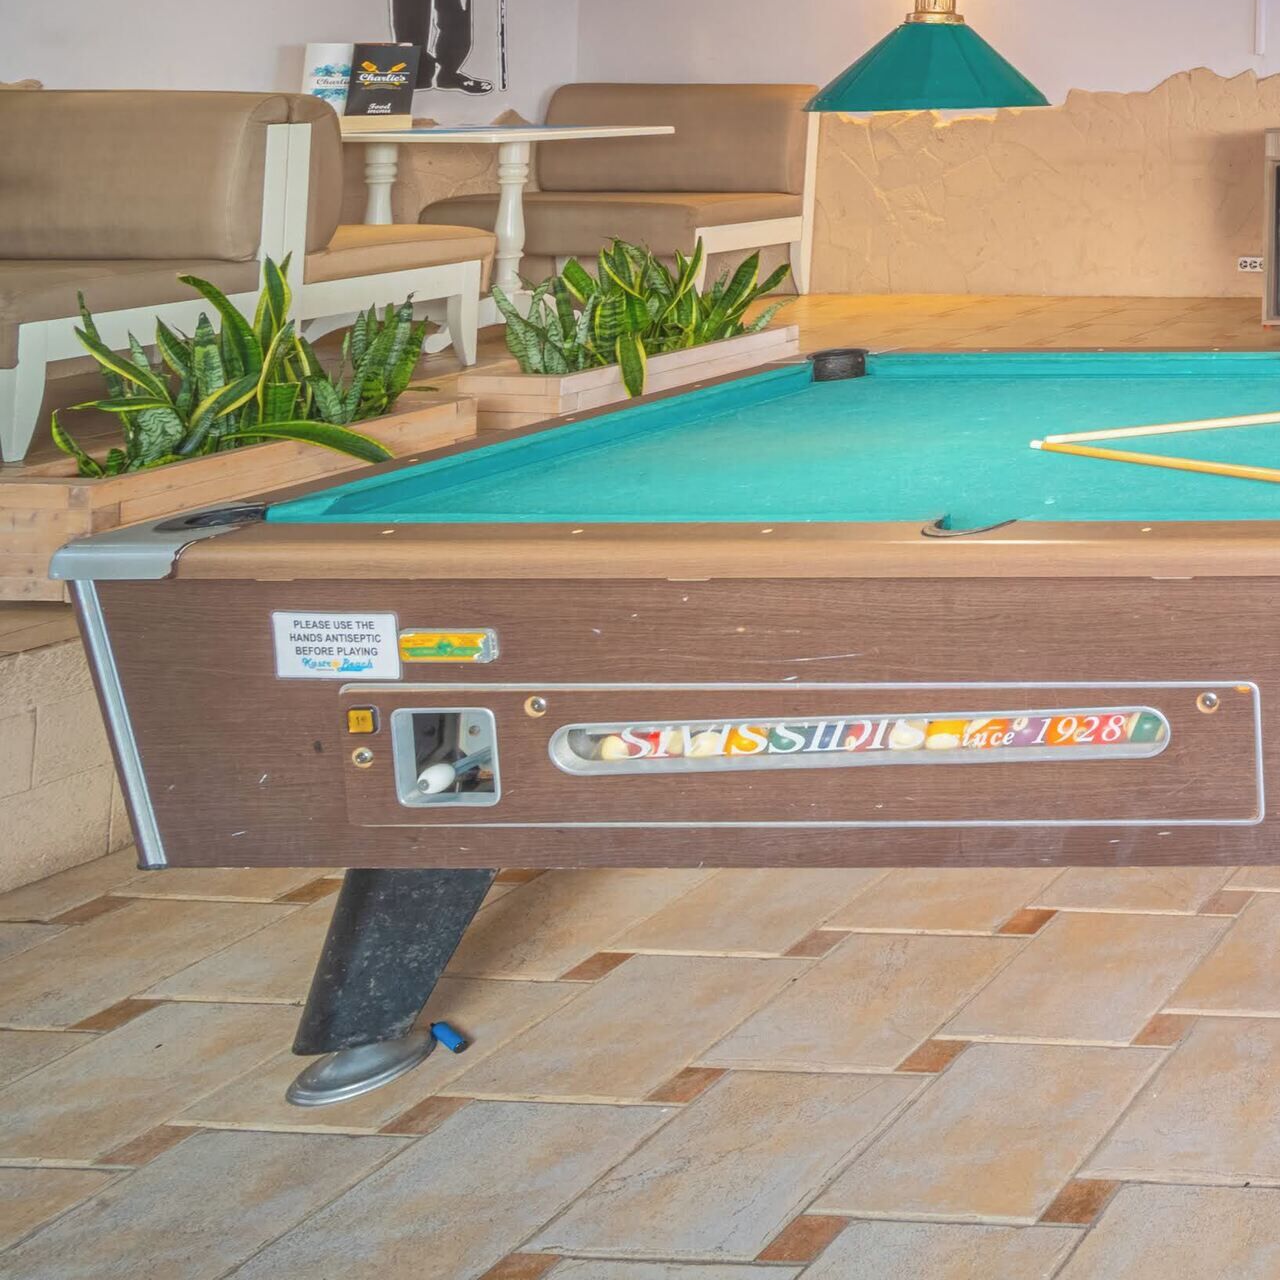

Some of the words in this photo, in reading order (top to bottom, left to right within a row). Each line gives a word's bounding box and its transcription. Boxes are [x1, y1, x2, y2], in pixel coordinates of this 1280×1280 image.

[359, 73, 406, 82] Charlie's
[293, 620, 331, 630] PLEASE
[333, 620, 353, 630] USE
[355, 620, 375, 630] THE
[289, 633, 323, 643] HANDS
[325, 633, 382, 644] ANTISEPTIC
[295, 646, 335, 656] BEFORE
[336, 647, 378, 657] PLAYING
[1031, 714, 1127, 744] 1928
